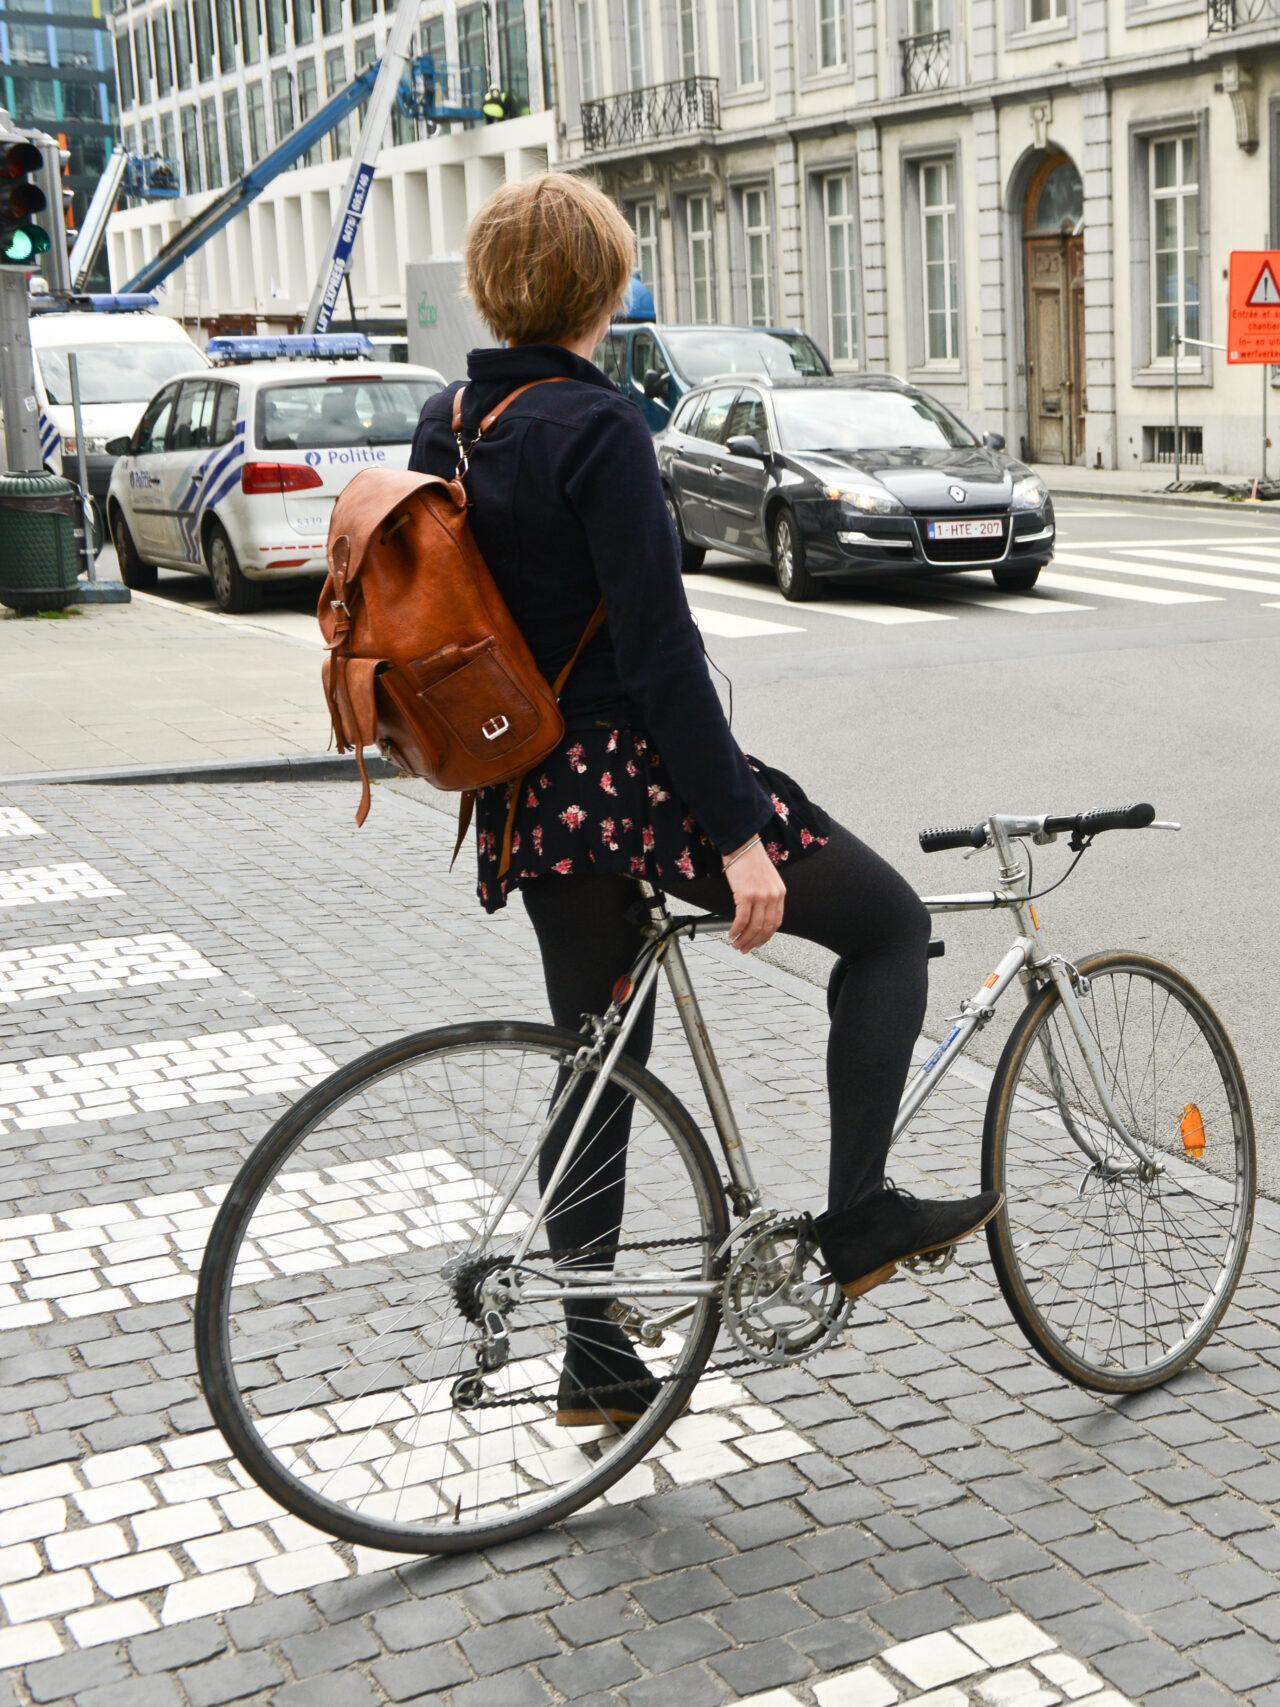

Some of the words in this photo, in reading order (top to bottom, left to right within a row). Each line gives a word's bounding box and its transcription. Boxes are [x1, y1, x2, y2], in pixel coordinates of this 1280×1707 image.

[316, 307, 332, 333] LIFT
[324, 257, 346, 306] EXPRESS
[1248, 322, 1280, 331] chantier
[328, 447, 387, 465] Politie
